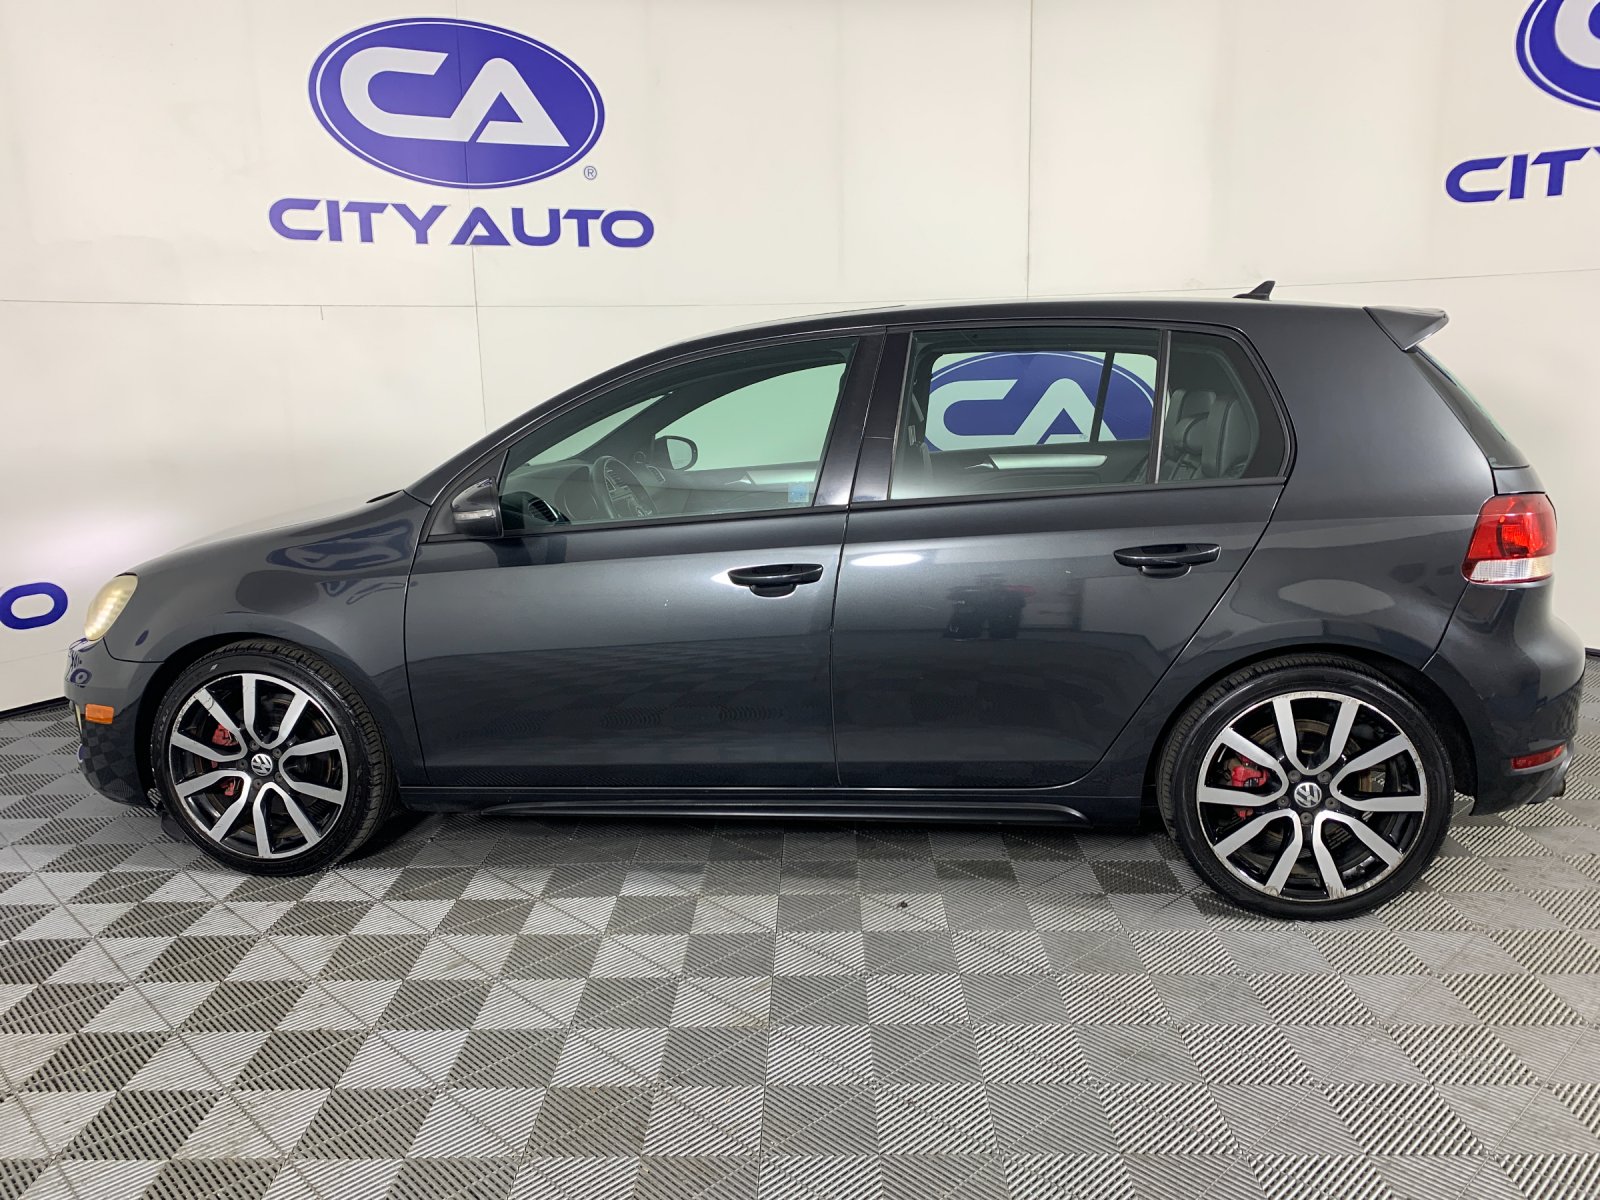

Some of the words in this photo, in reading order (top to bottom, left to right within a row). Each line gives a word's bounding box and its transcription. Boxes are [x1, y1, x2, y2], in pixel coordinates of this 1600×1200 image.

[340, 46, 570, 147] CA
[1446, 146, 1600, 203] CIT
[268, 198, 449, 245] CITY
[450, 206, 655, 248] AUTO
